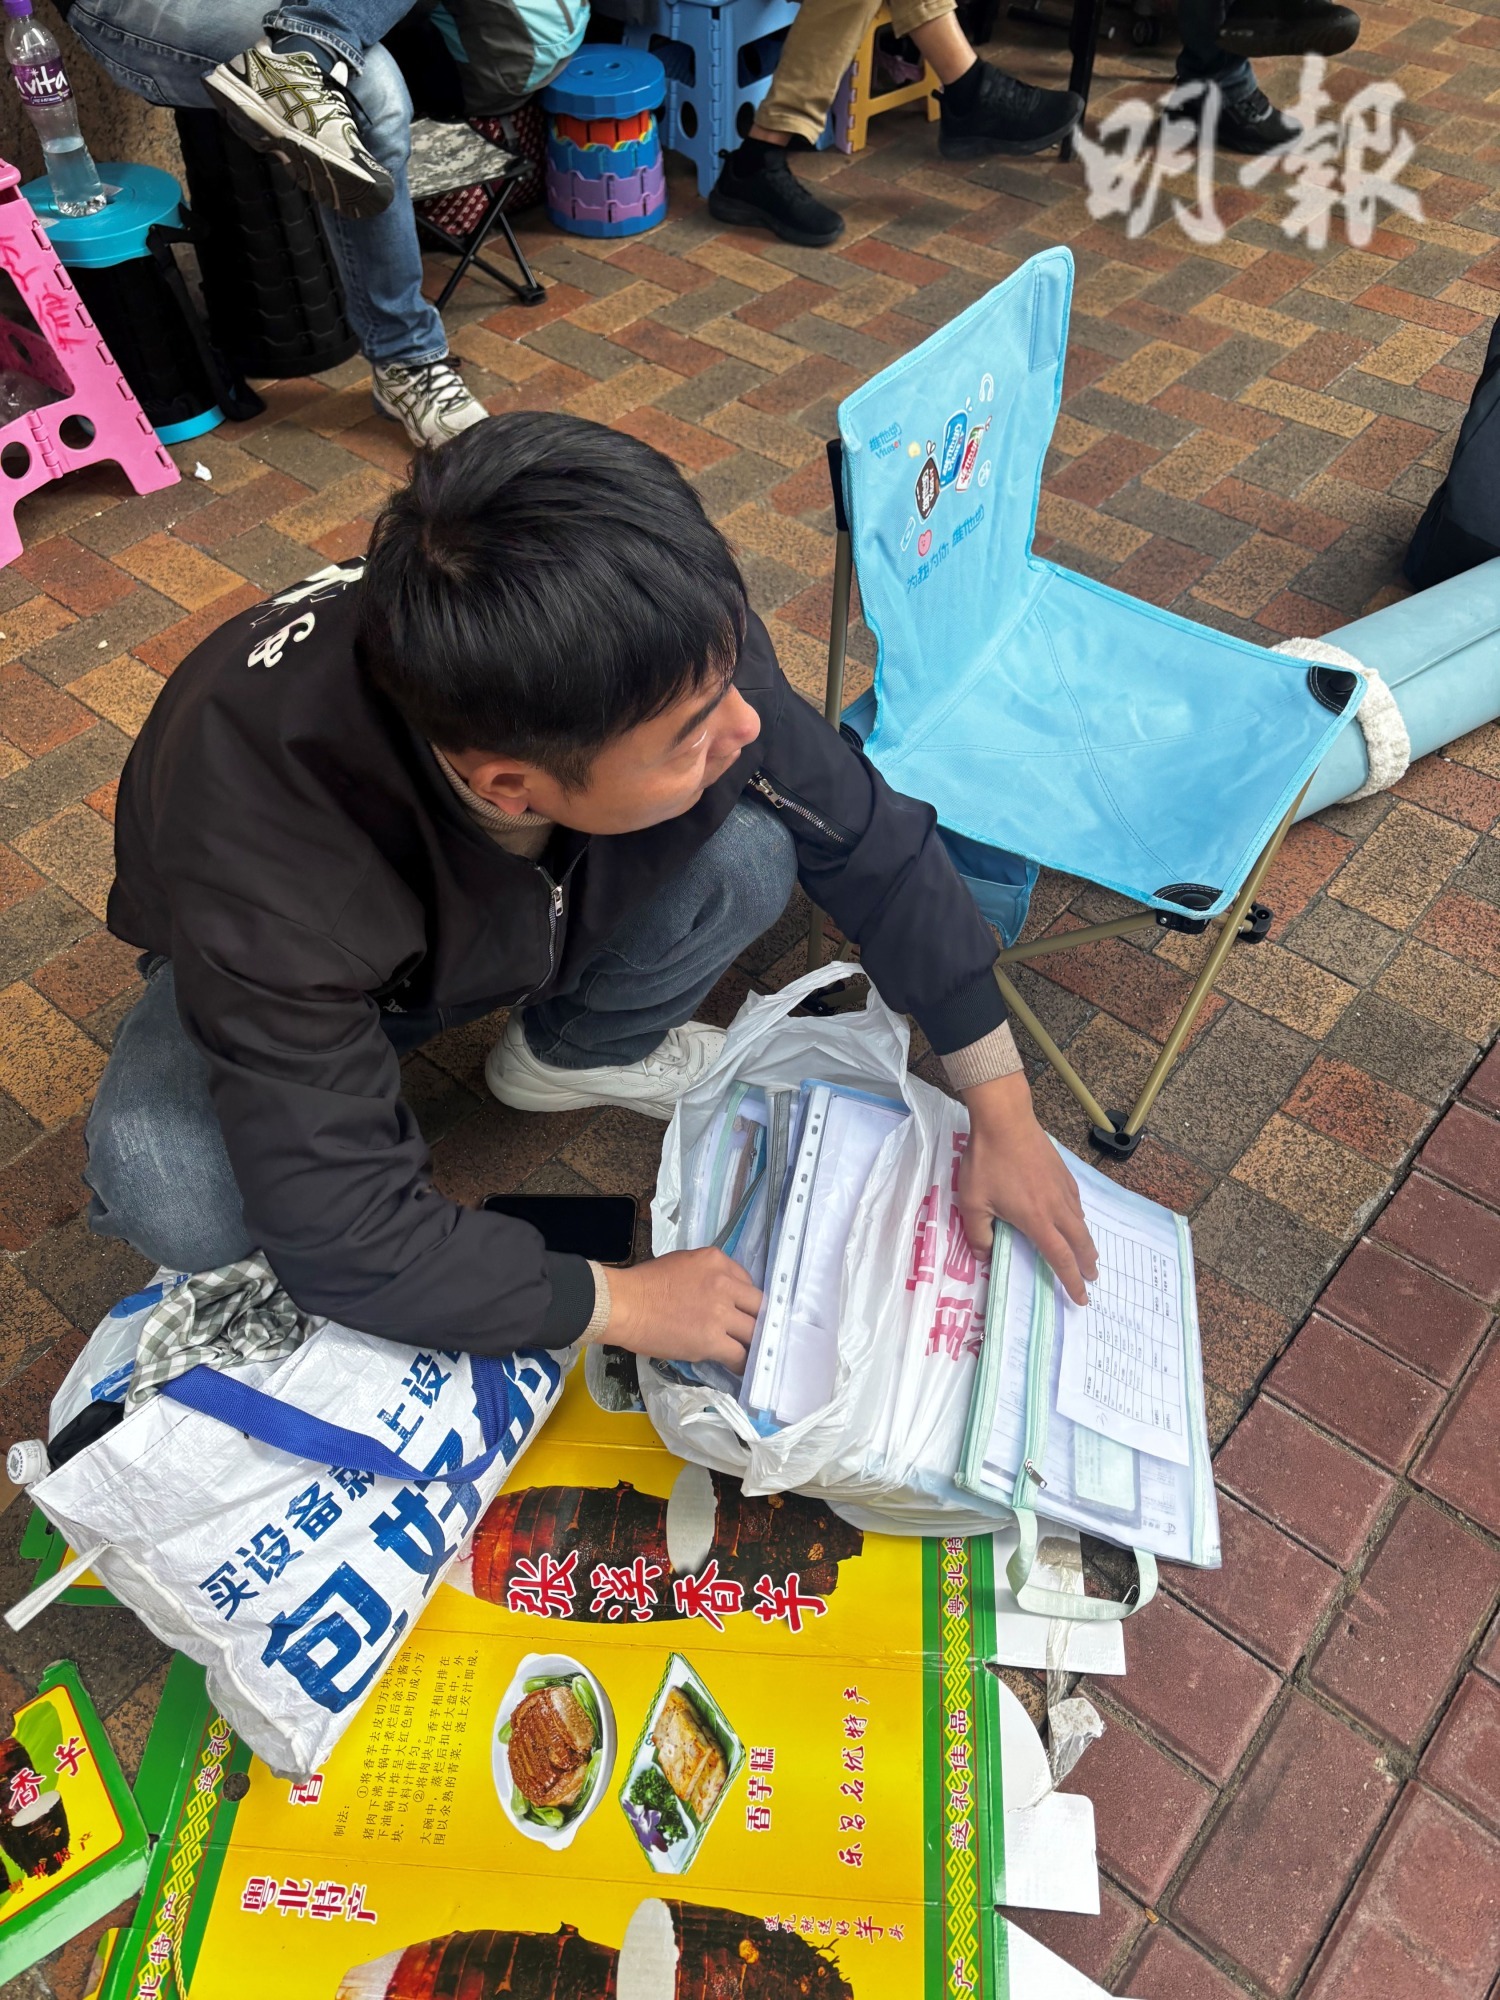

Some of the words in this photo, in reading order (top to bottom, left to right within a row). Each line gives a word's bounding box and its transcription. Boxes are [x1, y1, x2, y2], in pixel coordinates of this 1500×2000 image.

[24, 65, 68, 96] vita
[9, 1735, 87, 1812] 香芋
[197, 1714, 232, 1793] 送礼
[745, 1746, 775, 1834] 香芋糕
[837, 1685, 870, 1868] 乐昌名优特产
[948, 1709, 972, 1851] 送礼佳品
[241, 1875, 378, 1924] 粤北特产
[763, 1911, 906, 1945] 送礼就送好芋头
